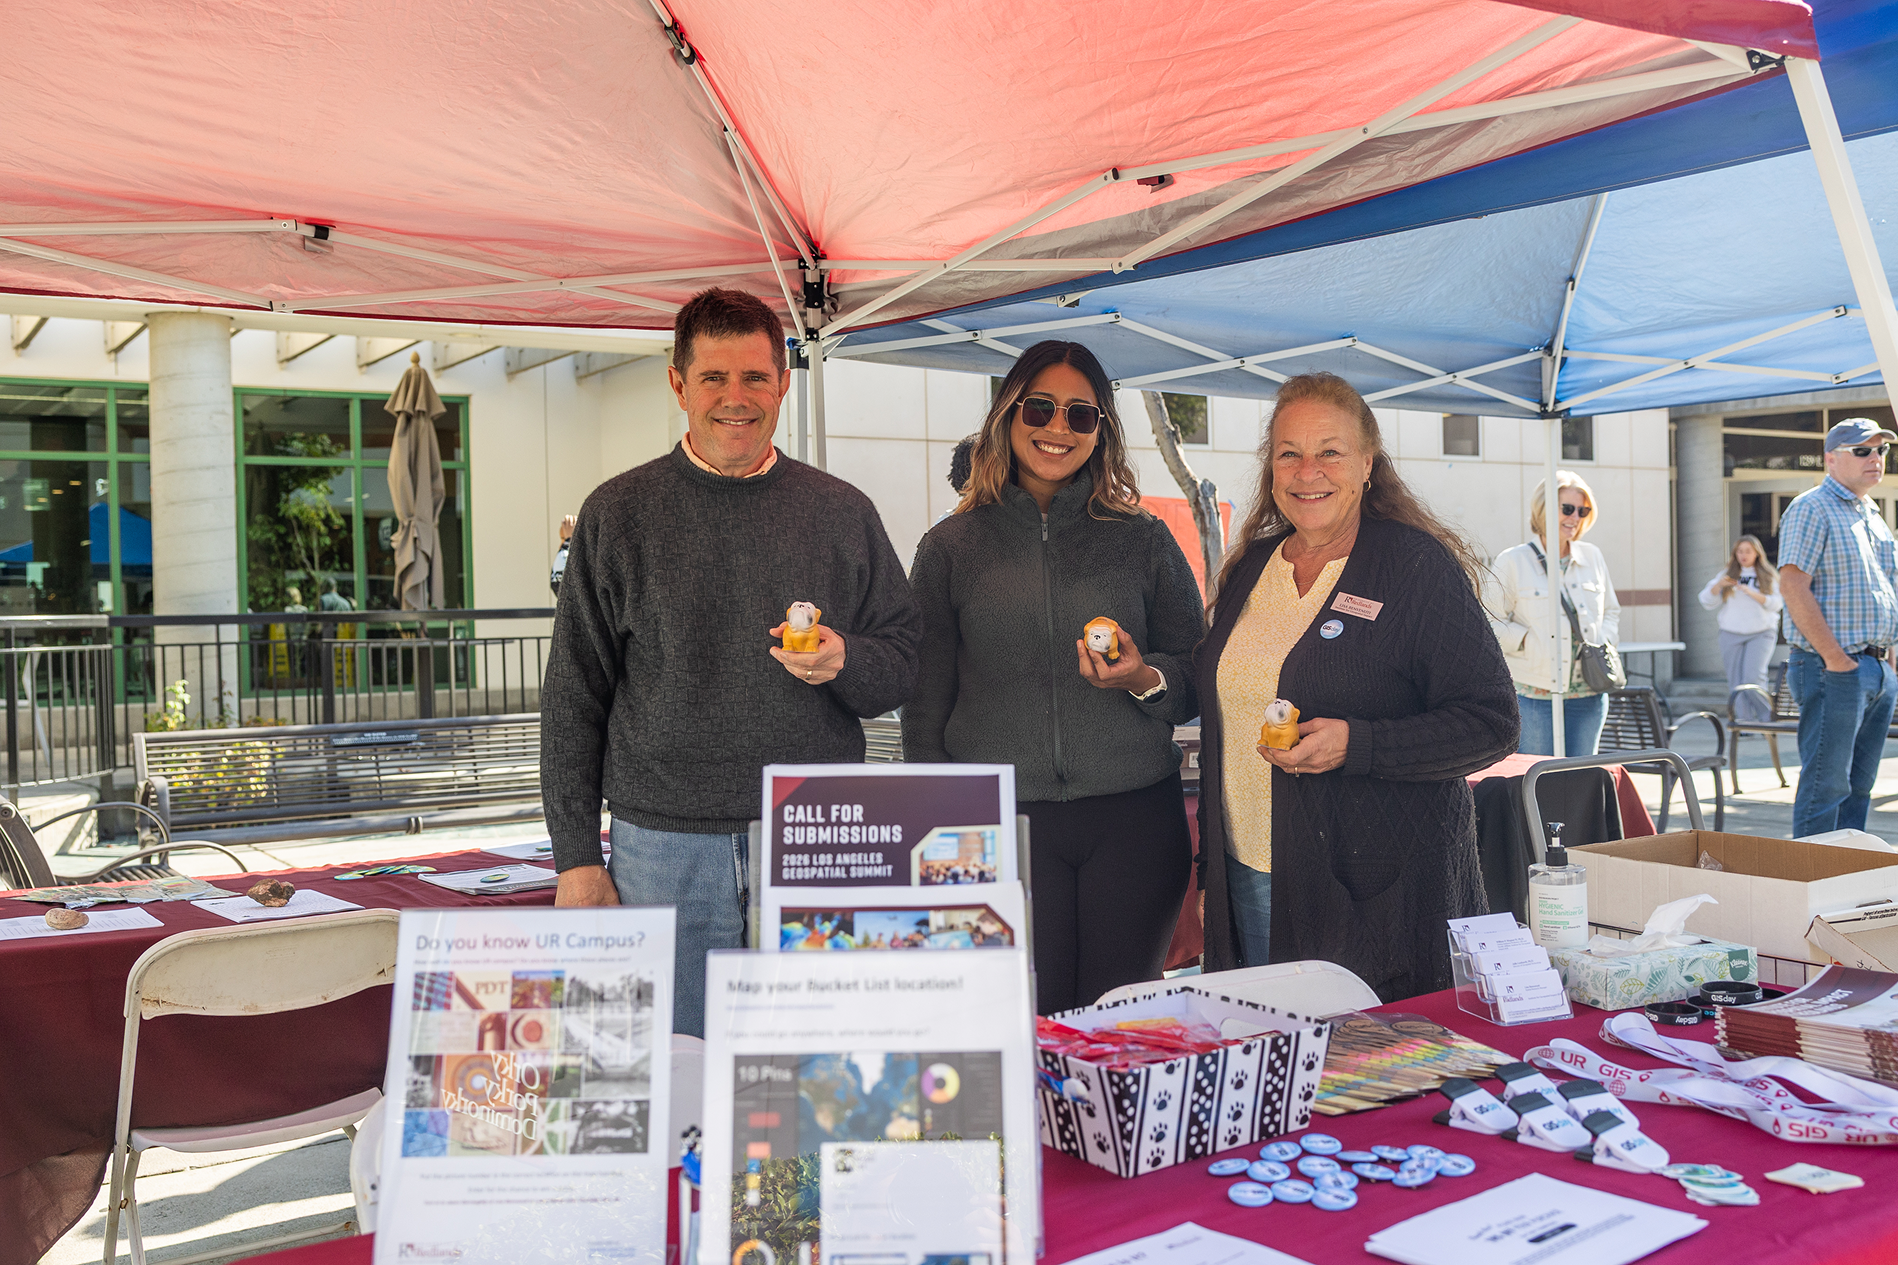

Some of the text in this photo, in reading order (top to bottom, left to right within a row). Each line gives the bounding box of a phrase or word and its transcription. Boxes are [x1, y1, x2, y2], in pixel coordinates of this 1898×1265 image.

[784, 804, 864, 823] CALL FOR
[783, 824, 902, 845] SUBMISSIONS
[812, 853, 833, 866] LOS
[835, 852, 883, 866] ANGELES
[782, 864, 893, 880] GEOSPATIAL SUMMIT
[416, 931, 645, 953] Do you know UR Campus?
[475, 981, 508, 995] PDT
[727, 975, 963, 994] Map your Bucket List location!
[1711, 995, 1736, 1004] GISday
[1676, 1016, 1698, 1025] GISday
[738, 1064, 792, 1082] 10 Pins
[1560, 1051, 1633, 1080] UR GIS
[1788, 1123, 1828, 1139] GIS
